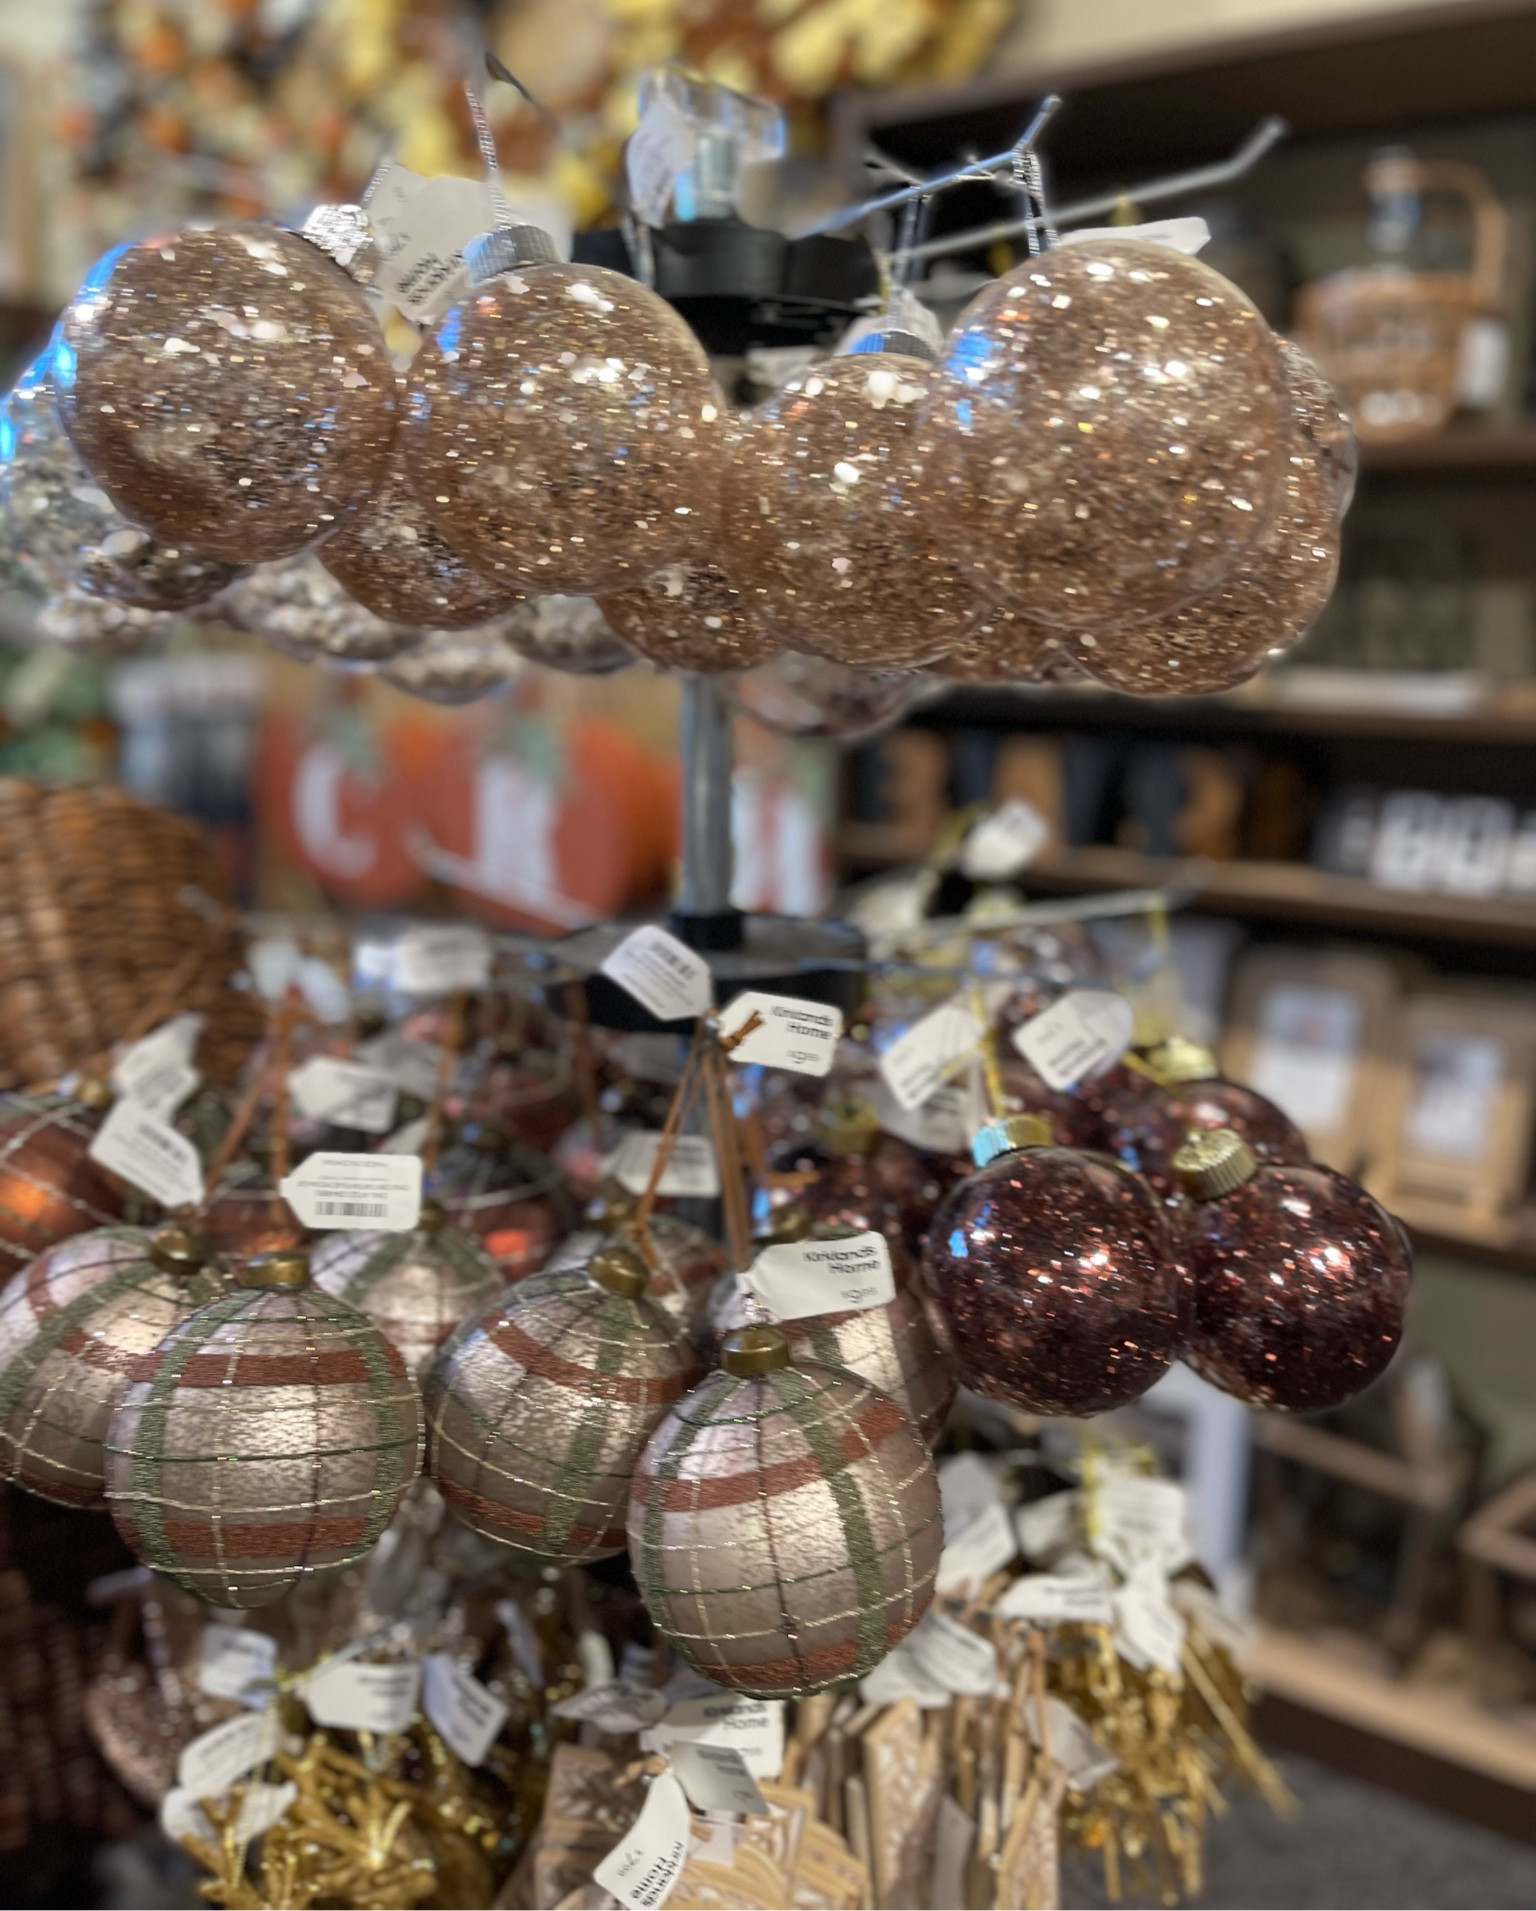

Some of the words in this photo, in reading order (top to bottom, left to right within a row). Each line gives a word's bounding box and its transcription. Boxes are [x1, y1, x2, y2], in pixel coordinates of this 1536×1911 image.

[786, 1021, 833, 1041] Home
[827, 1259, 881, 1275] Home
[628, 1856, 669, 1900] Home
